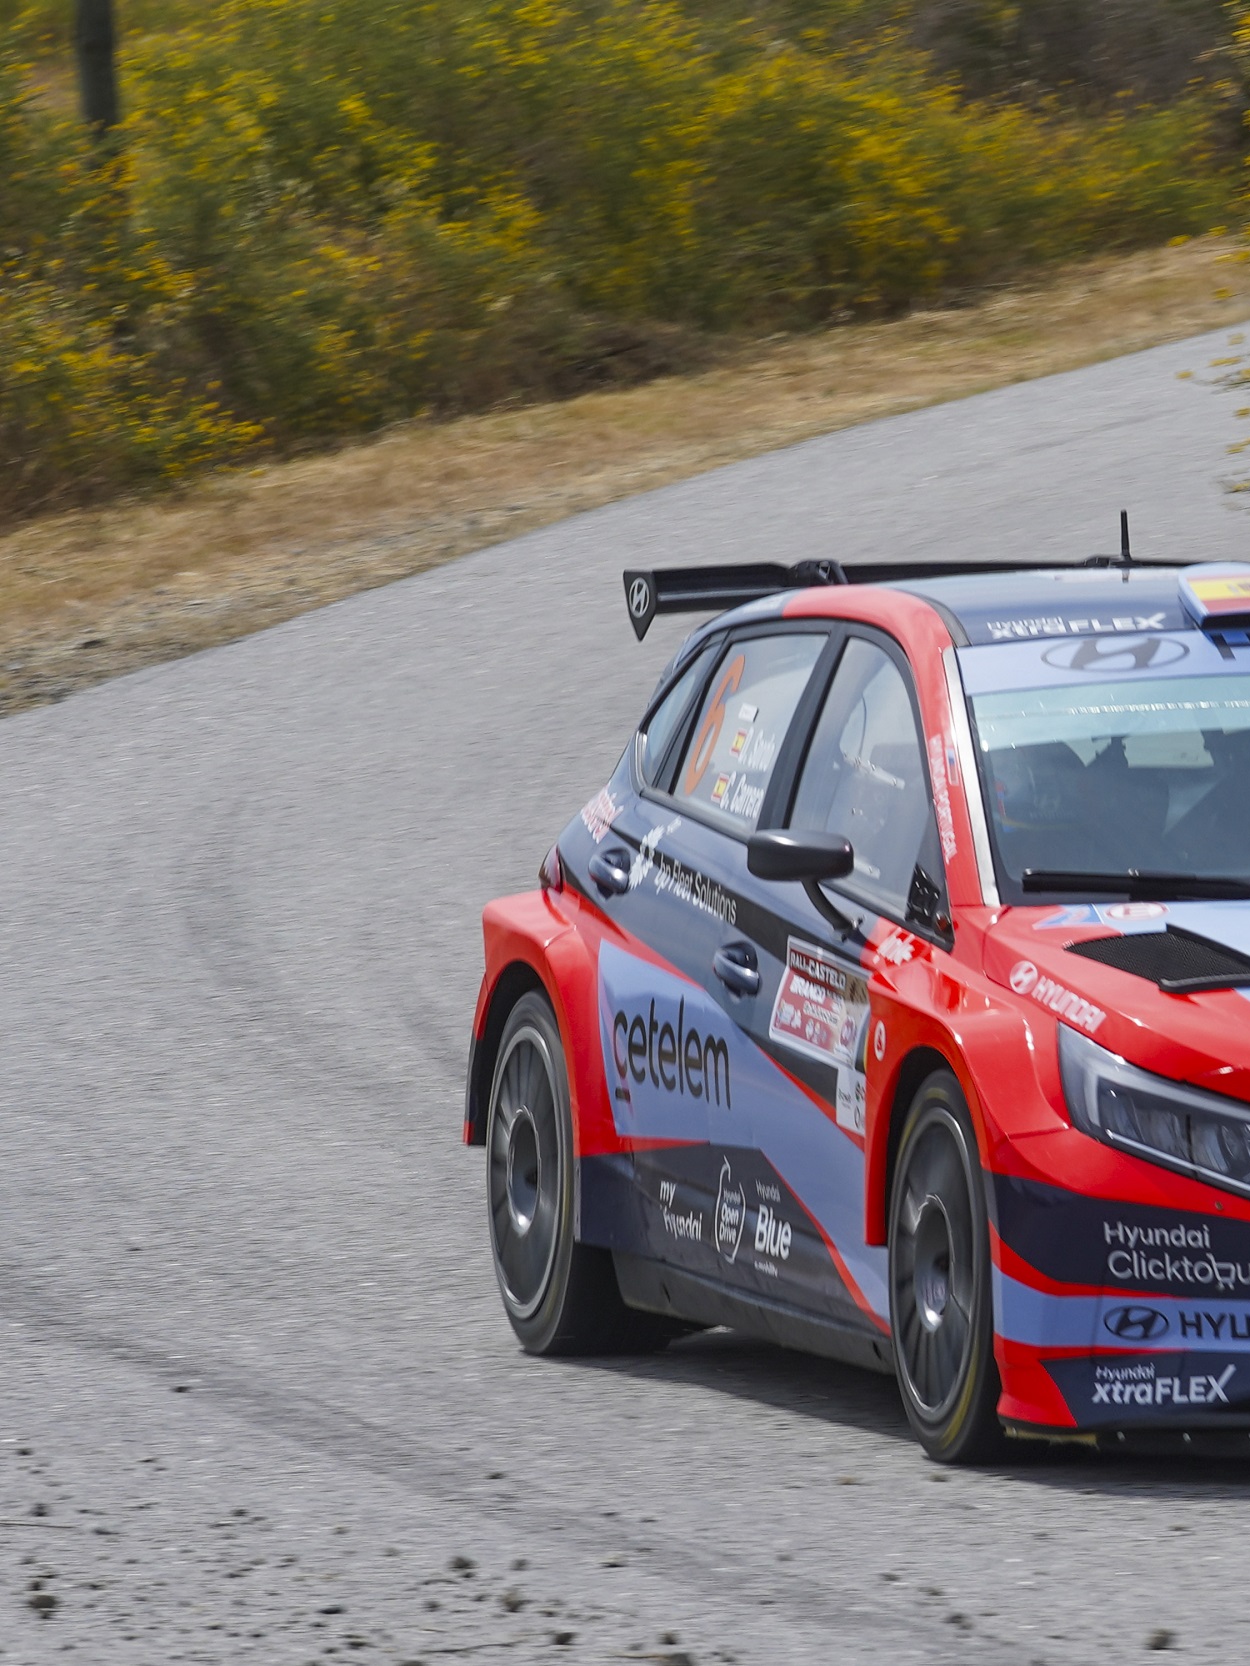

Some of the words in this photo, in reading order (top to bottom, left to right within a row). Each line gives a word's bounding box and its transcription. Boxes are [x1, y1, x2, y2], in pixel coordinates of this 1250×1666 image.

[684, 655, 745, 796] 6
[668, 859, 694, 901] Fleet
[693, 872, 737, 925] Solutions
[1031, 975, 1107, 1033] HYUNDAI
[613, 994, 731, 1111] cetelem
[660, 1180, 677, 1209] my
[754, 1203, 792, 1260] Blue
[1104, 1221, 1211, 1250] Hyundai
[1092, 1363, 1237, 1404] xtraFLEX
